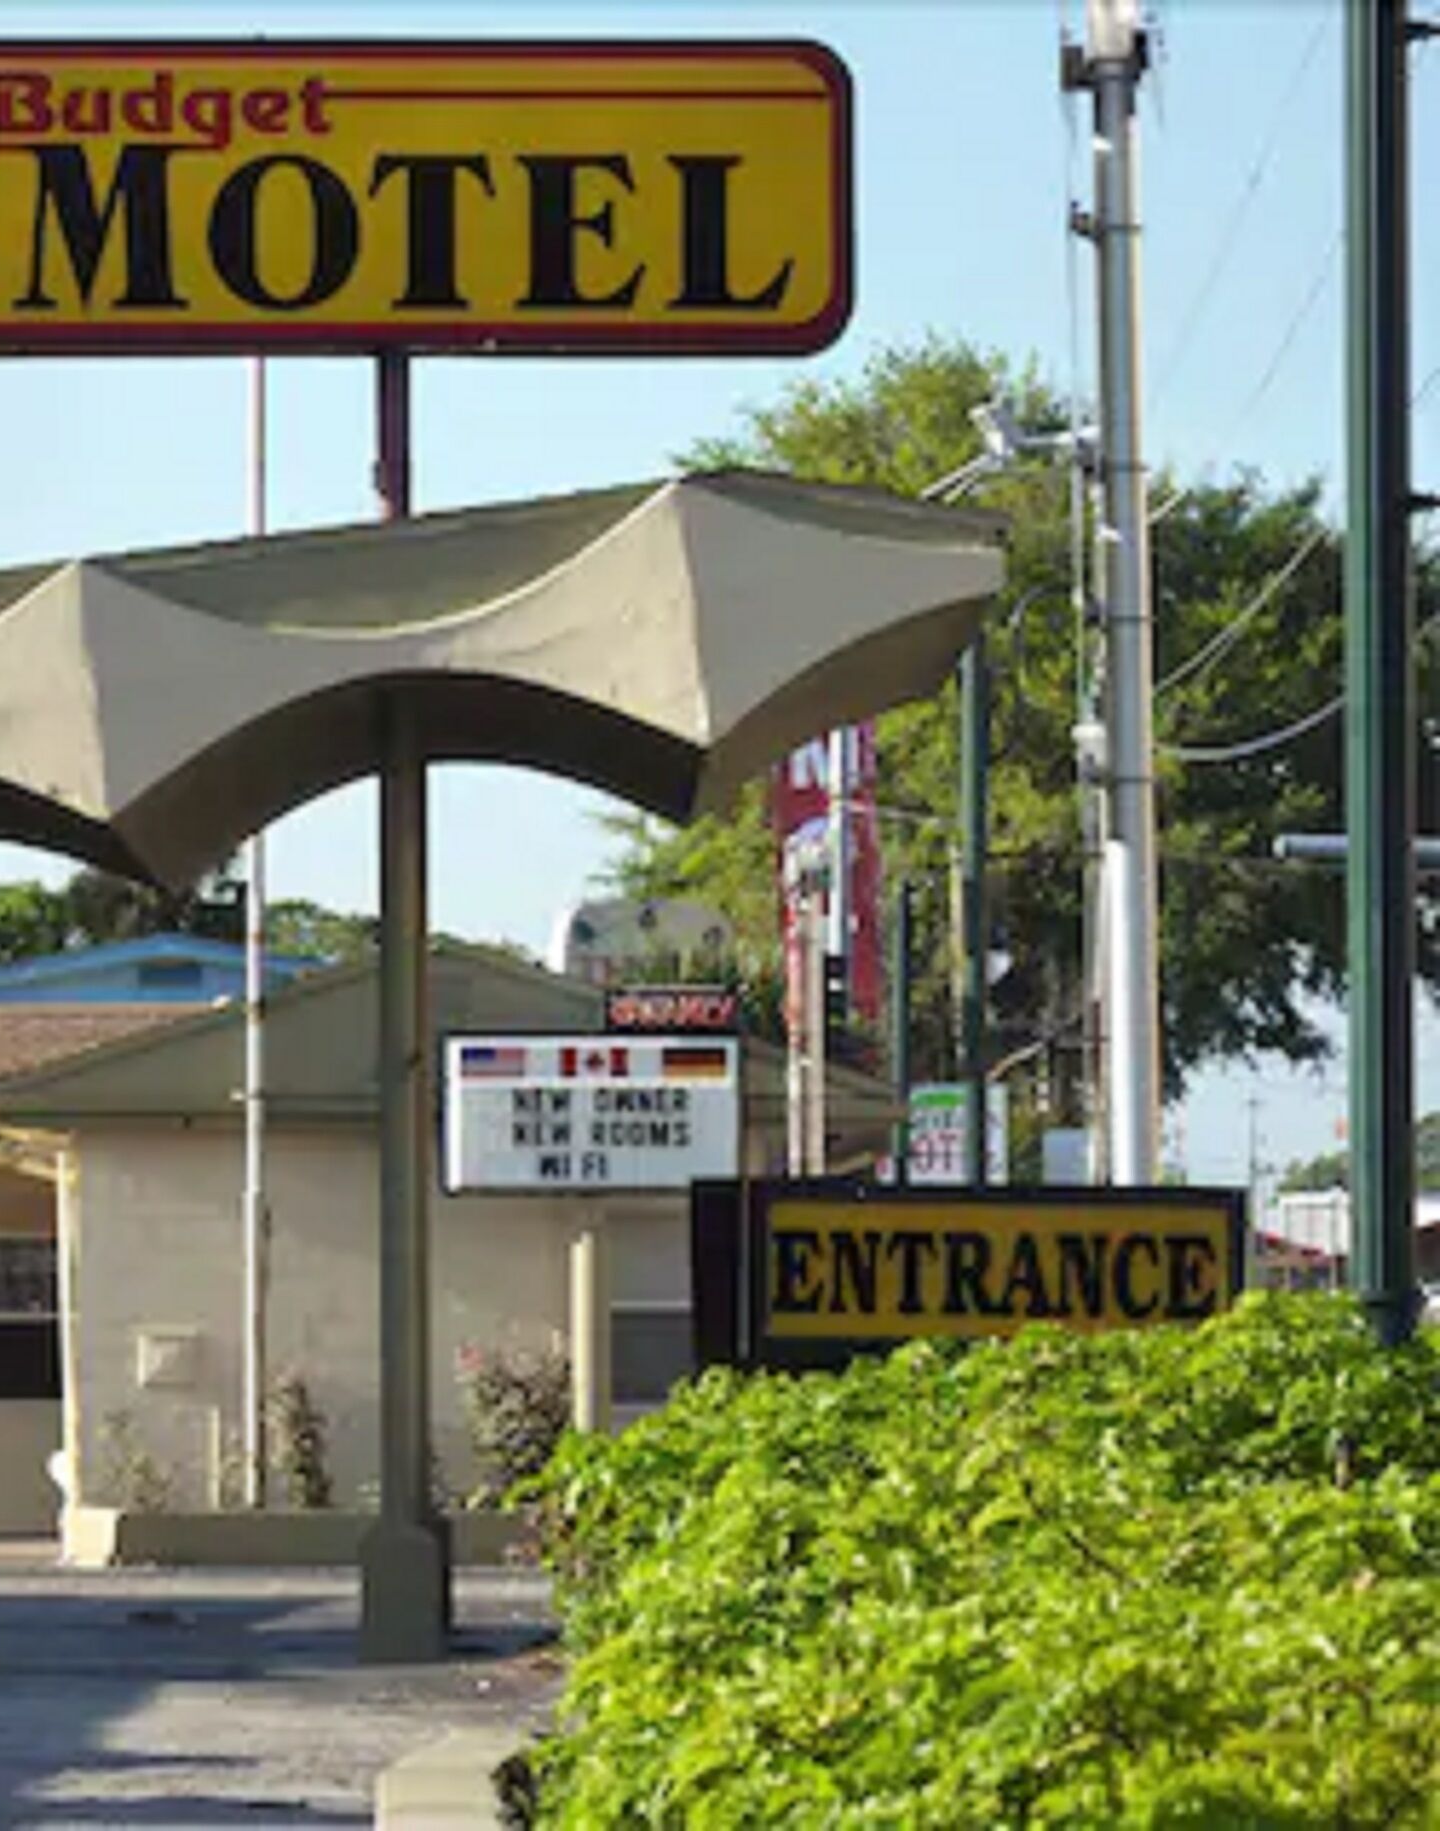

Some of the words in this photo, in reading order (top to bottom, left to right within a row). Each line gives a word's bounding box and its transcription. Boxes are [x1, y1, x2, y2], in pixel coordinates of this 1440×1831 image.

[12, 143, 795, 312] MOTEL
[512, 1087, 571, 1112] NEW
[593, 1087, 689, 1112] OWNER
[512, 1121, 571, 1146] NEW
[592, 1121, 690, 1147] ROOMS
[771, 1230, 1218, 1319] ENTRANCE
